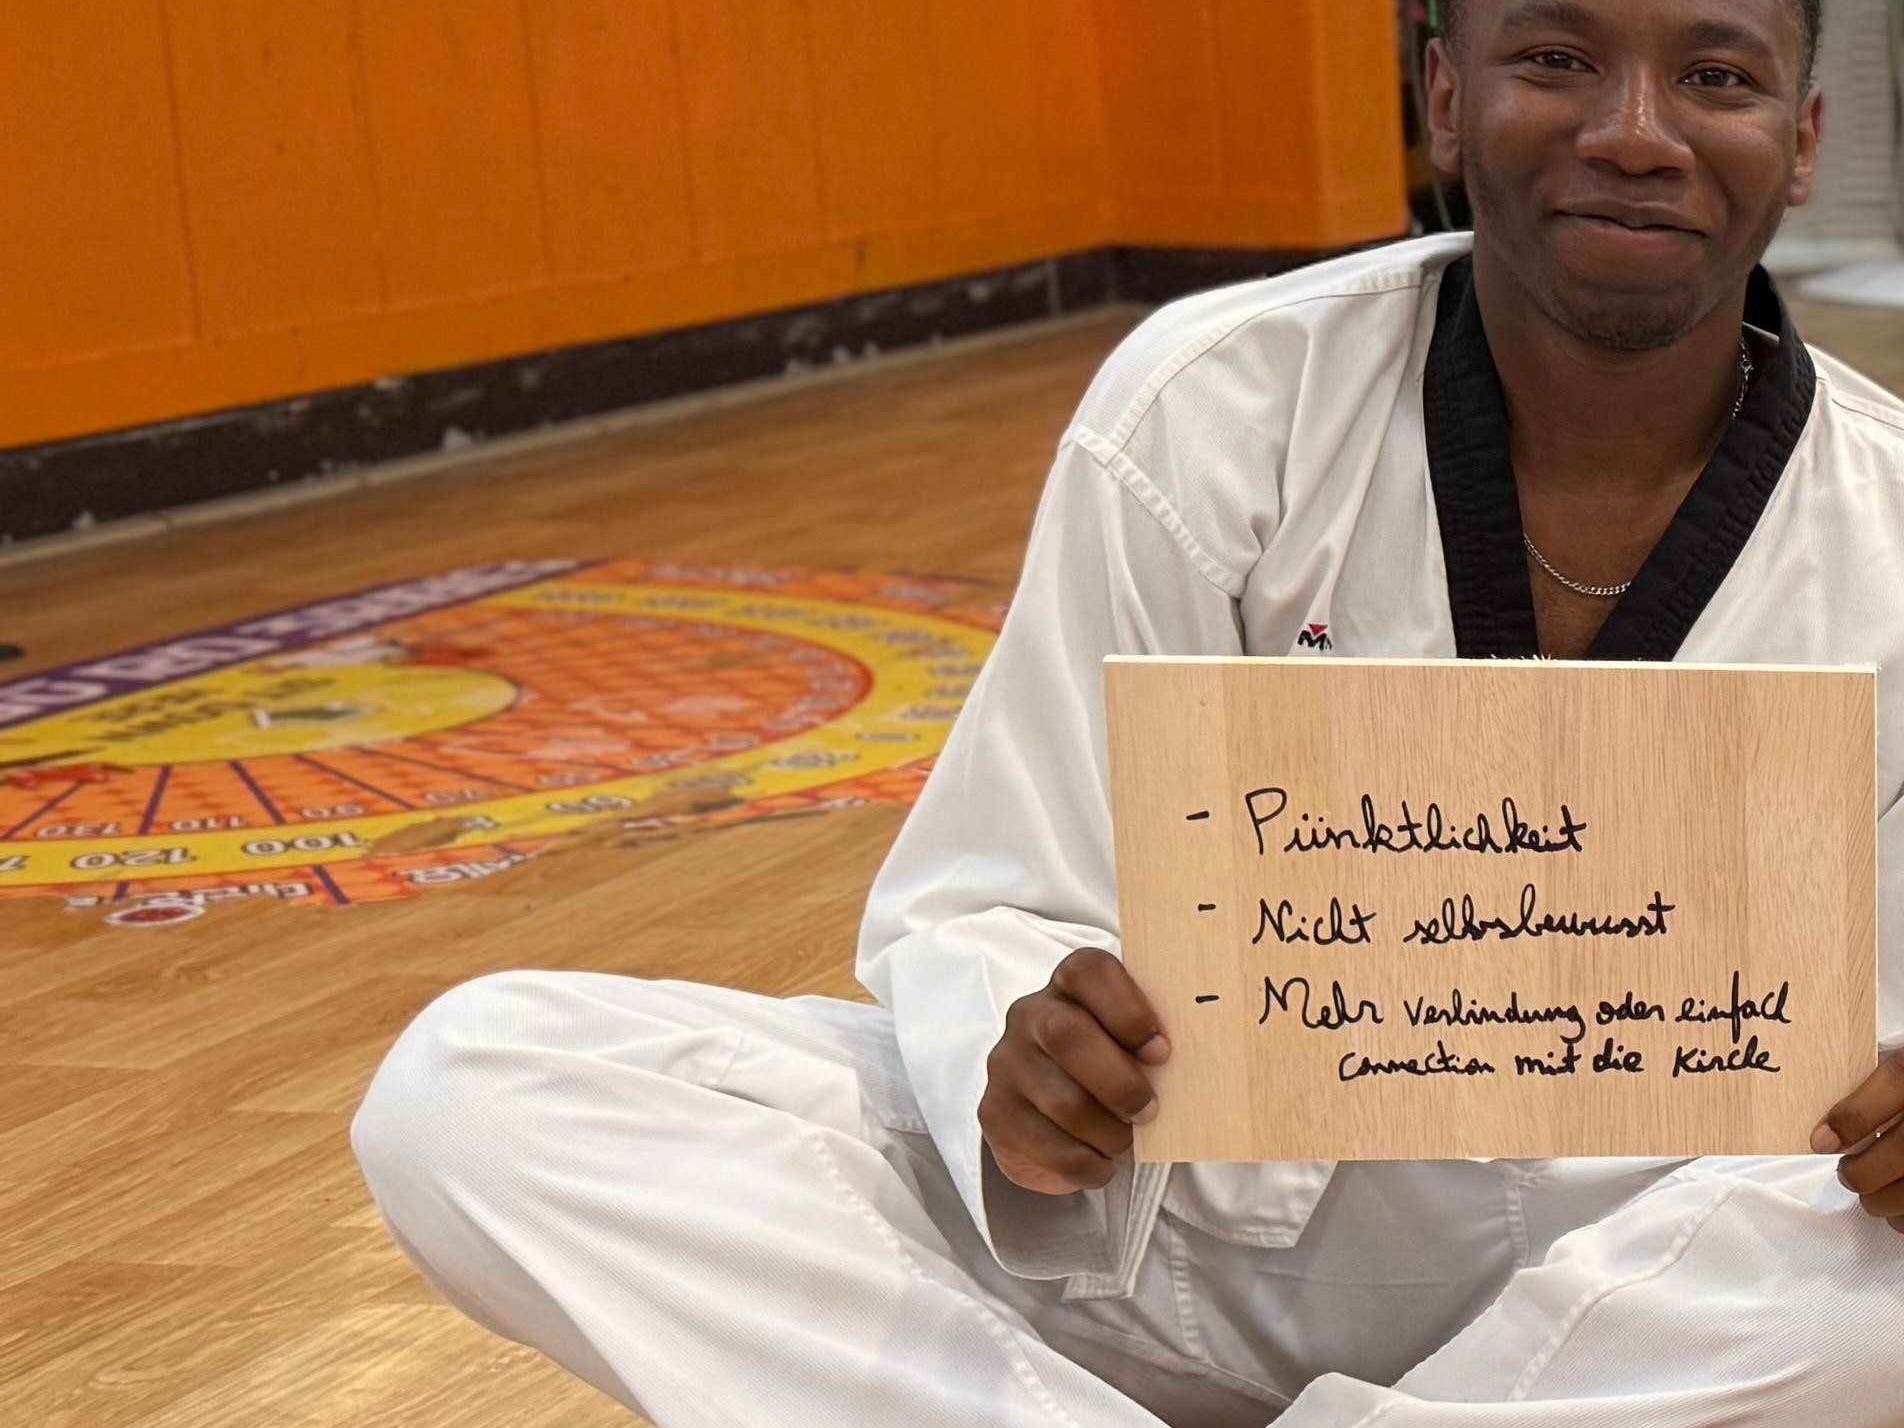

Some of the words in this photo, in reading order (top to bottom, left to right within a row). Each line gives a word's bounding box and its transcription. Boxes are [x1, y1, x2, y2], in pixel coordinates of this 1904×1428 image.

[70, 845, 200, 871] 120
[240, 831, 374, 857] 100
[1252, 896, 1378, 945] Nicht
[1259, 975, 1385, 1030] Mehr
[1595, 990, 1666, 1025] oder
[1674, 969, 1793, 1045] einfach
[1514, 1042, 1582, 1076] mit
[1592, 1037, 1645, 1073] die
